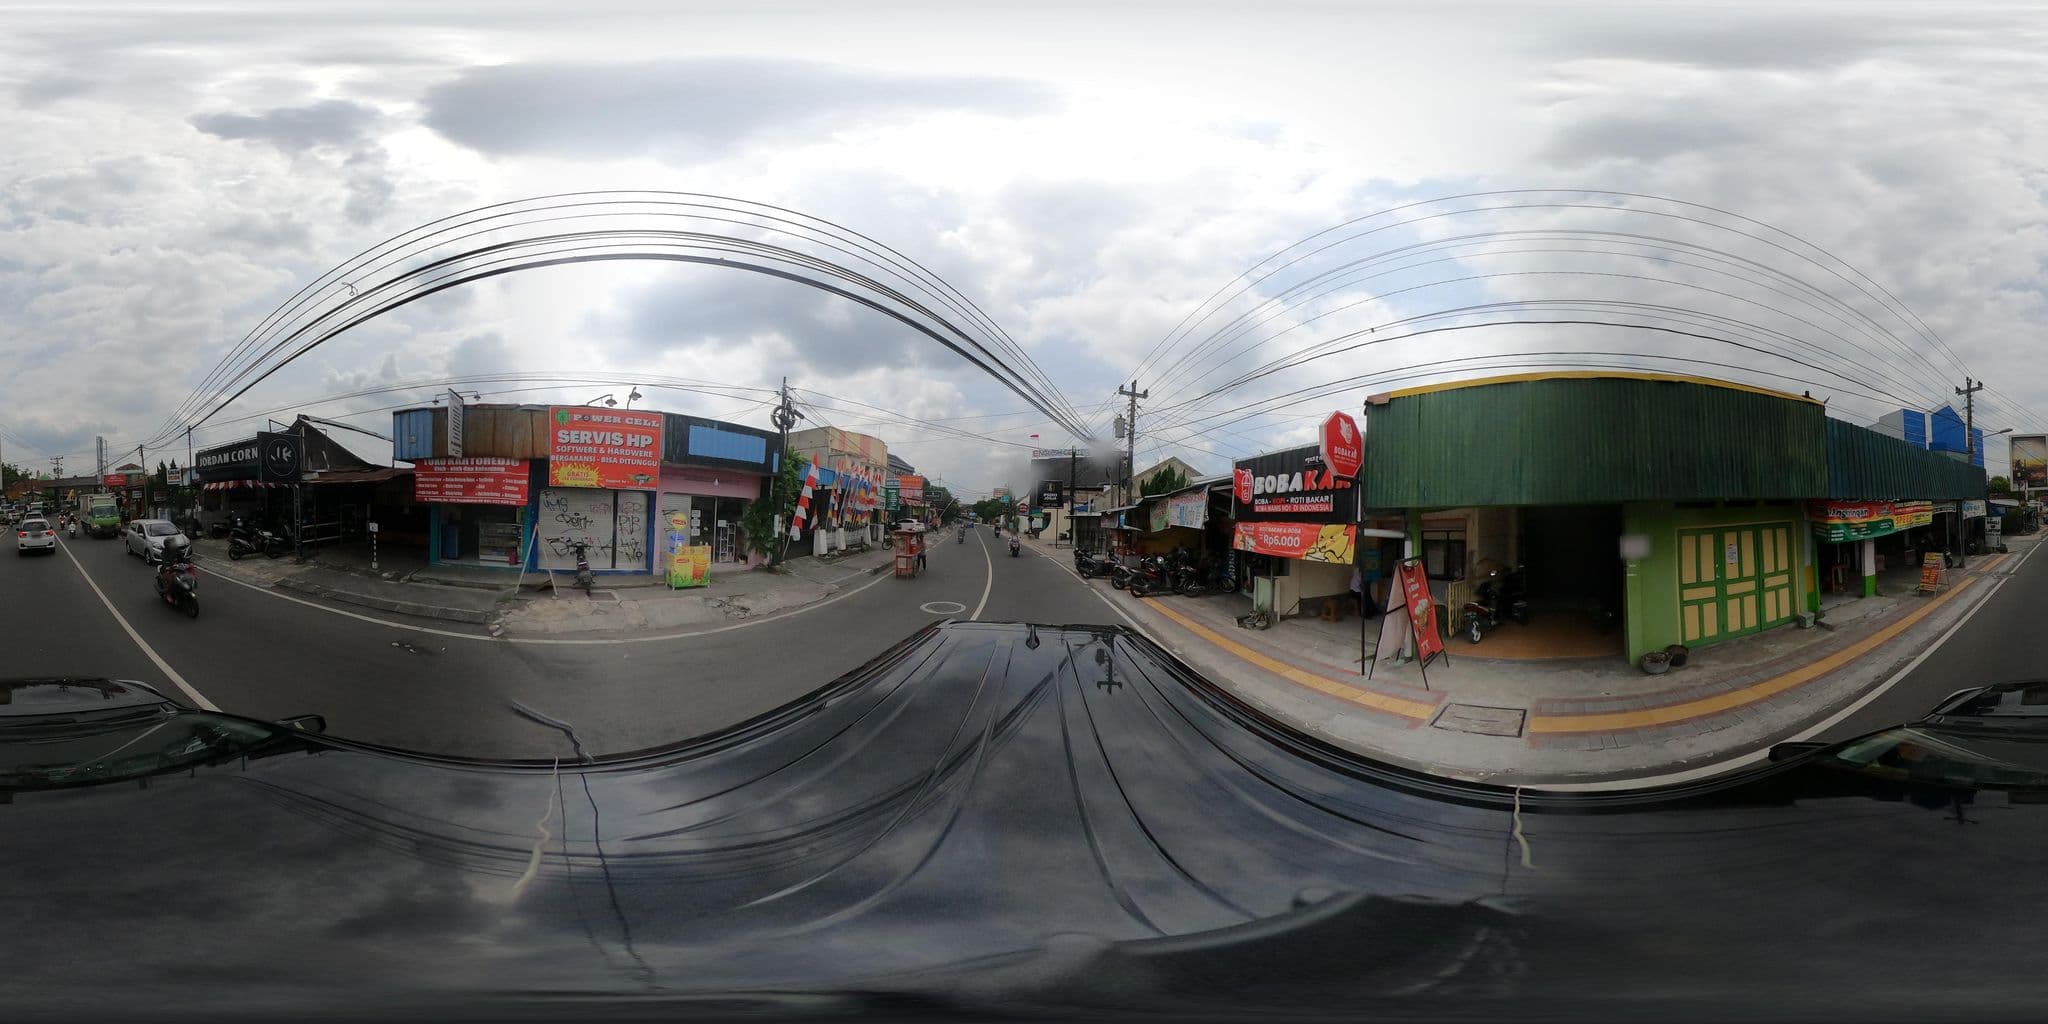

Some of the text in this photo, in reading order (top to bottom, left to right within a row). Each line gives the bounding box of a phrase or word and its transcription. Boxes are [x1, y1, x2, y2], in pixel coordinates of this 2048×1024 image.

[573, 414, 659, 427] POWER CELL
[557, 430, 653, 448] SERVIS HP
[199, 447, 258, 467] JORDAN CORN
[556, 445, 598, 454] SOFTWERE
[607, 447, 653, 457] HARDWERE
[550, 454, 596, 463] BERGARANSI
[619, 458, 658, 467] DITUNGGU
[1290, 496, 1305, 504] ROTI
[1305, 494, 1330, 503] BAKAR
[1300, 503, 1330, 511] INDONESIA
[1263, 534, 1300, 548] Rp6.000
